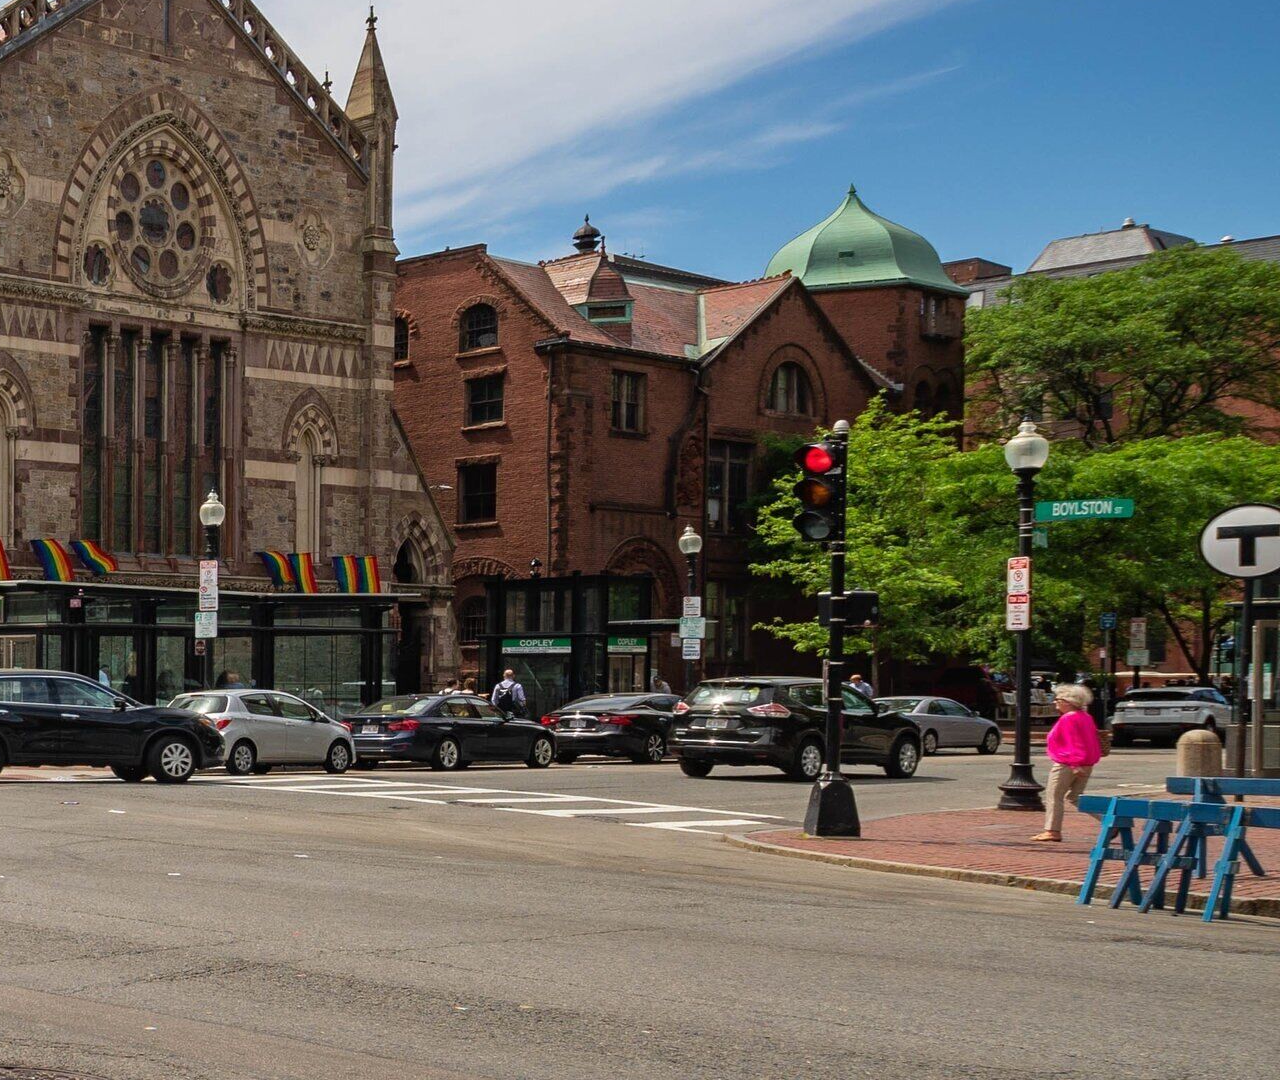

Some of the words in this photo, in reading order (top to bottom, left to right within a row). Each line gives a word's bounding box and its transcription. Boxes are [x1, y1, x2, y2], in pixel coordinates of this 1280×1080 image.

[1052, 500, 1112, 516] BOYLSTON
[1216, 524, 1280, 567] T
[519, 639, 554, 647] COPLEY
